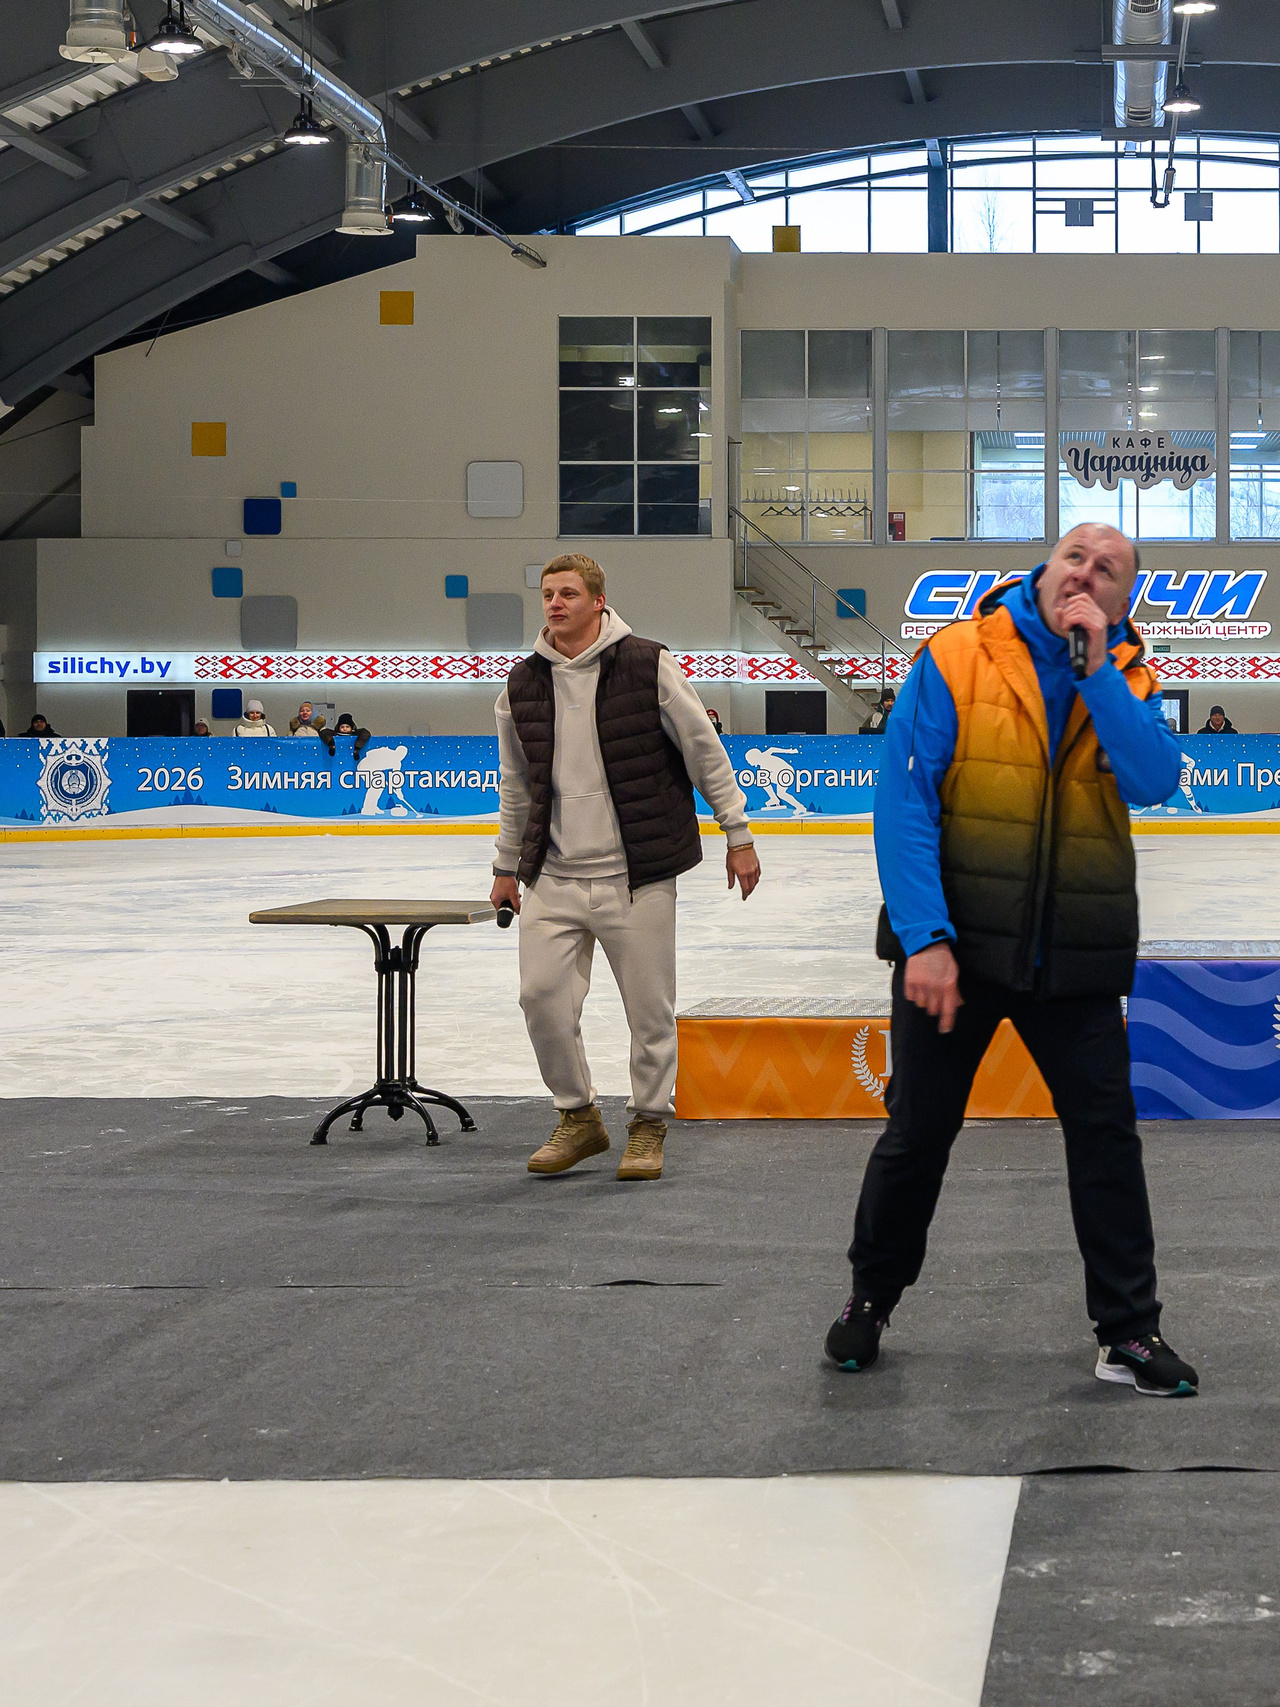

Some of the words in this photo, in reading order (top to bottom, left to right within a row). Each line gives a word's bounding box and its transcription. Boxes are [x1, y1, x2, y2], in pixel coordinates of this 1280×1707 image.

[1112, 437, 1165, 449] КАФЕ
[1215, 625, 1268, 638] ЦЕНТР
[48, 657, 172, 678] silichy.by
[137, 766, 204, 792] 2026
[227, 765, 332, 790] Зимняя
[339, 769, 499, 795] спартакиад
[1179, 768, 1229, 787] ами
